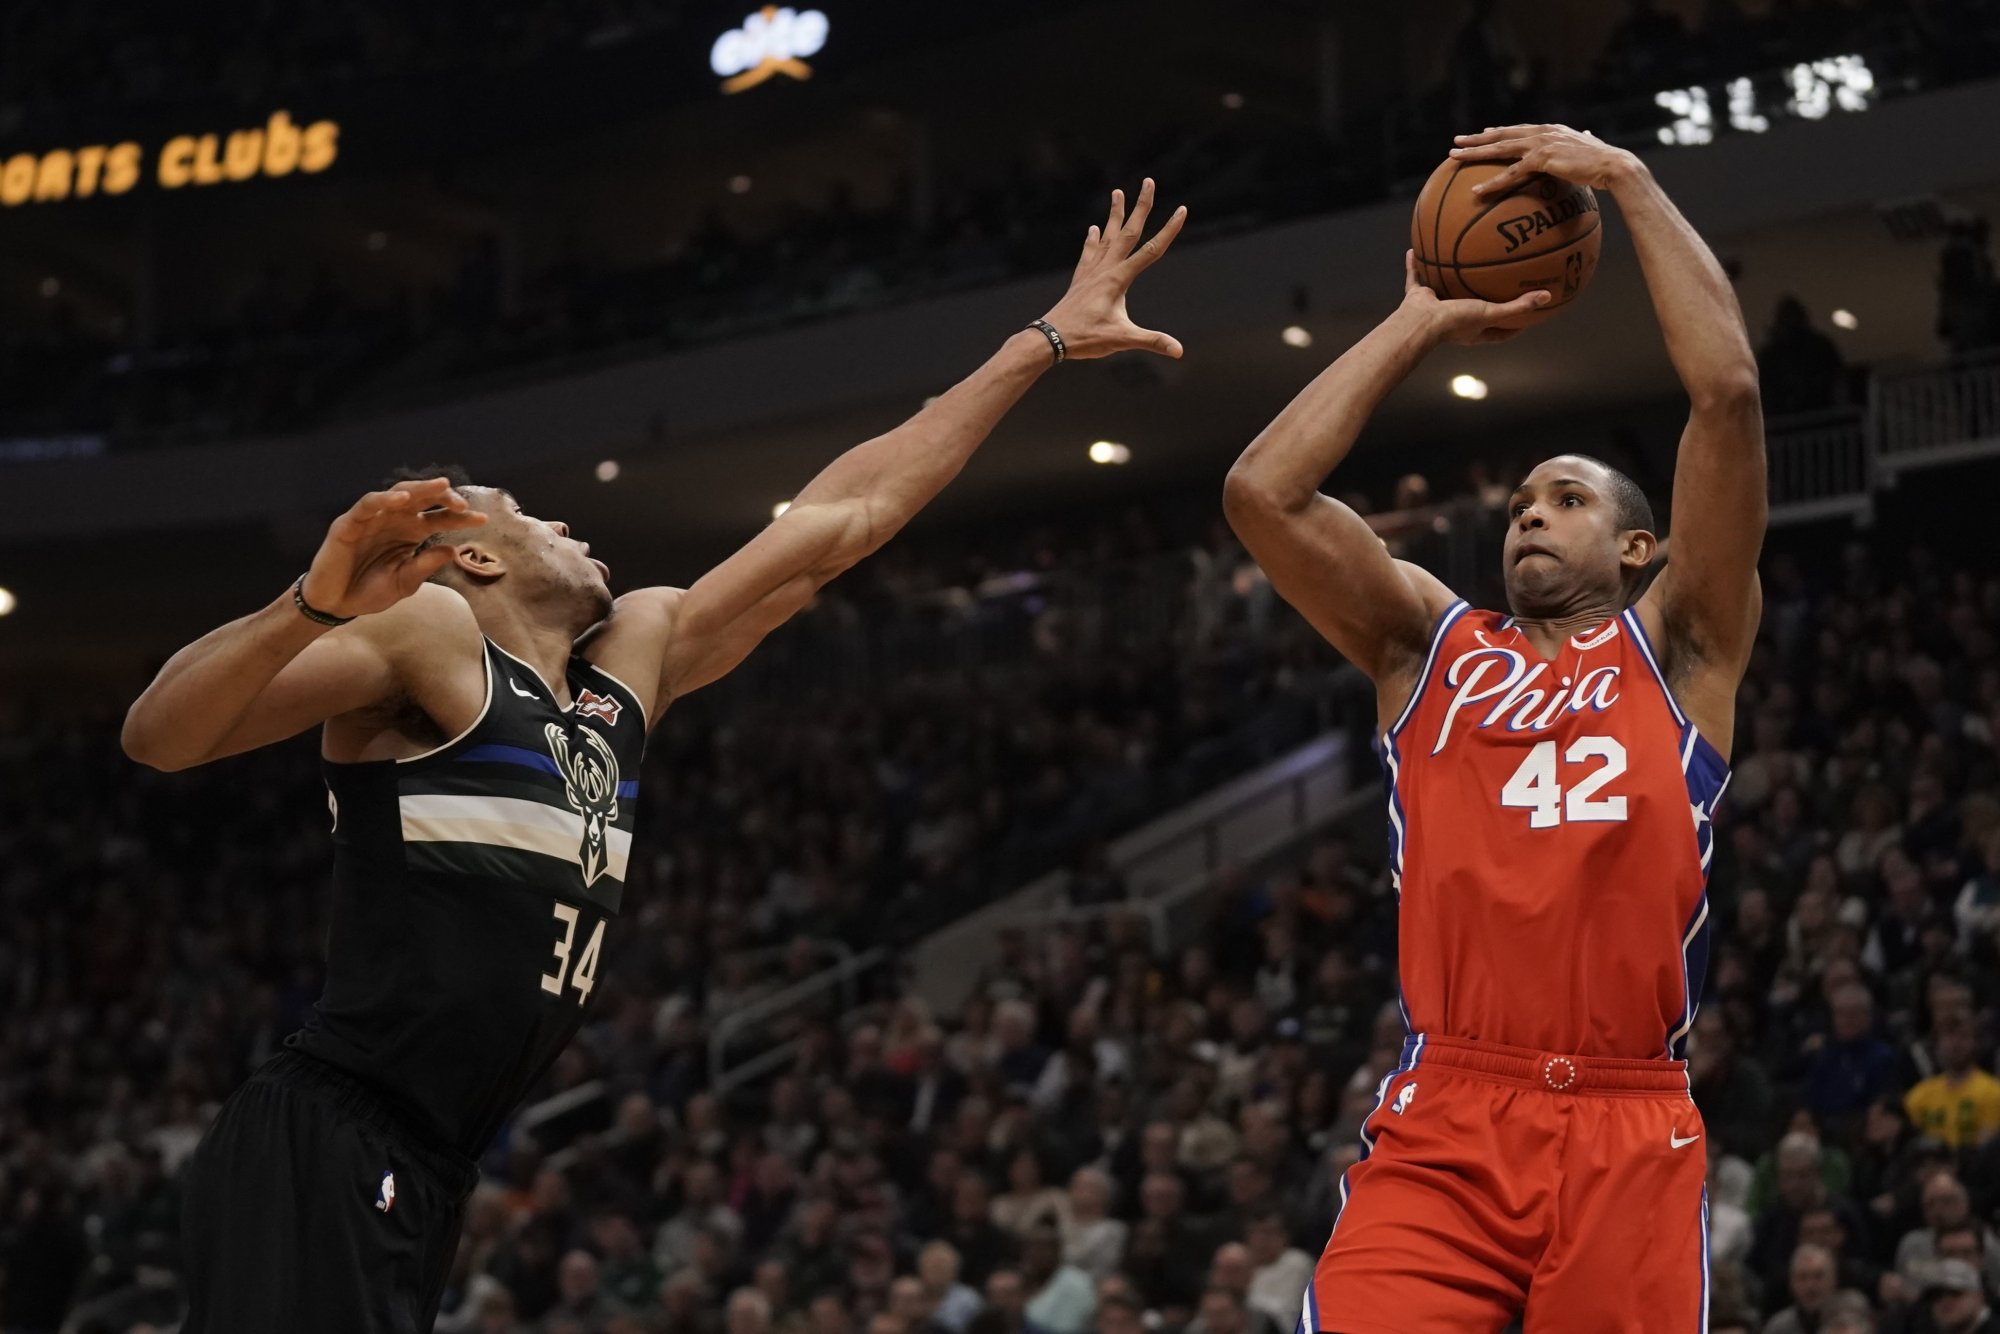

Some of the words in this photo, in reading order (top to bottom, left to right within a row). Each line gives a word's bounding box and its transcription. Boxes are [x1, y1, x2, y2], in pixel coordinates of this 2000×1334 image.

[0, 141, 142, 206] ORTS
[1496, 185, 1599, 254] SPALDIN
[1500, 735, 1628, 829] 42
[540, 901, 607, 1006] 34
